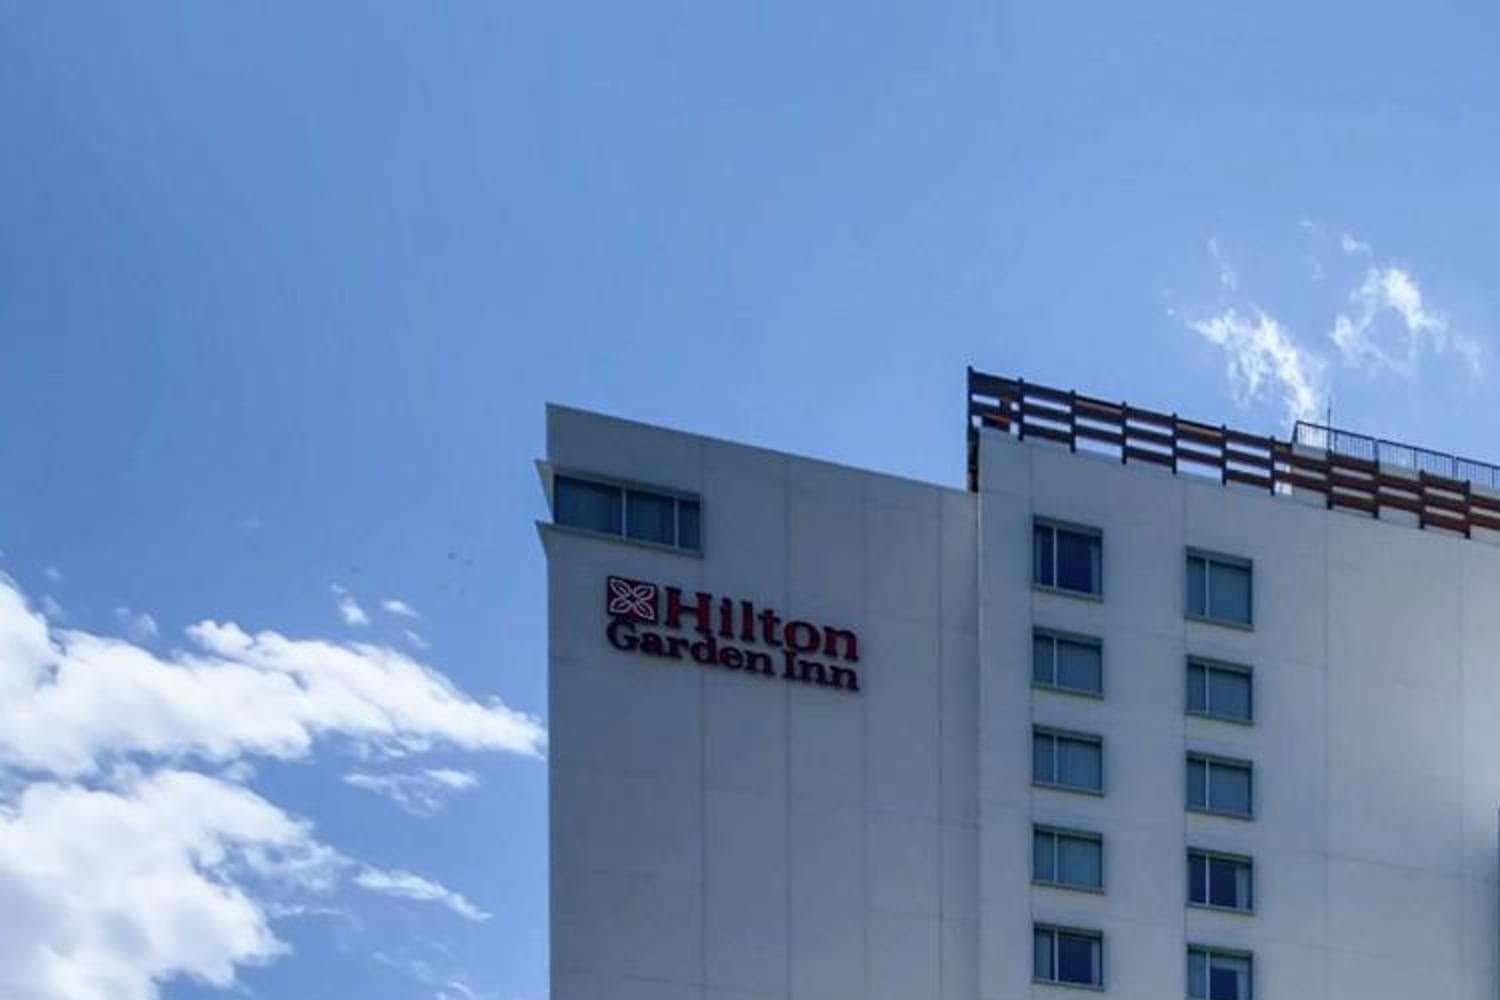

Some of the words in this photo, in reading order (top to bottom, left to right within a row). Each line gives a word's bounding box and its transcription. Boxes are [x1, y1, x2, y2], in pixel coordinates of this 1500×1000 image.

[606, 619, 775, 676] Garden
[782, 650, 860, 691] Inn
[665, 586, 860, 662] Hilton
